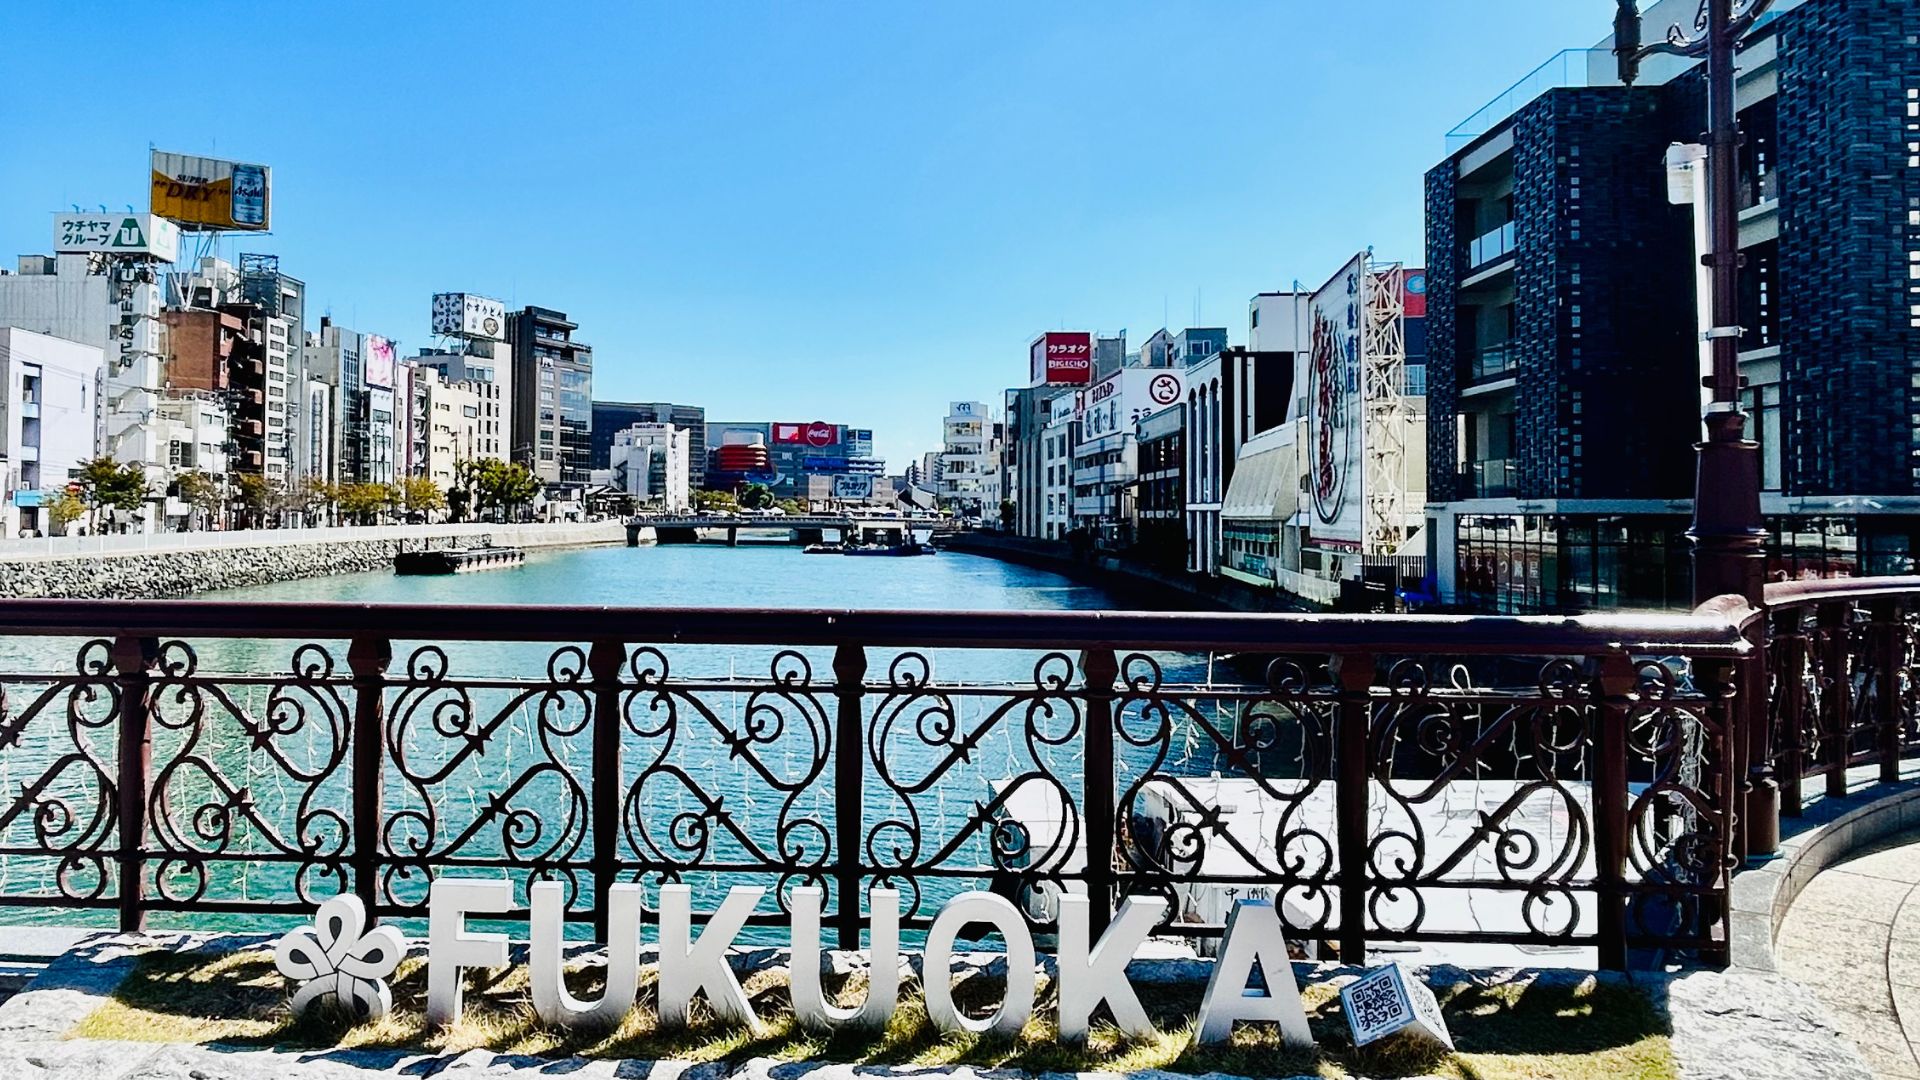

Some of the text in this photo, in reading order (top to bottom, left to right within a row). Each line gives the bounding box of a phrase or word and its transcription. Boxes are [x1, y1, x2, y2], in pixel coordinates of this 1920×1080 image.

[176, 173, 209, 183] SUPER
[62, 220, 111, 232] ウチヤマ
[62, 233, 111, 246] グループ
[466, 302, 503, 319] かすうどん
[1048, 344, 1089, 354] カラオケ
[1157, 378, 1174, 400] さ
[427, 878, 1316, 1049] FUKUOKA
